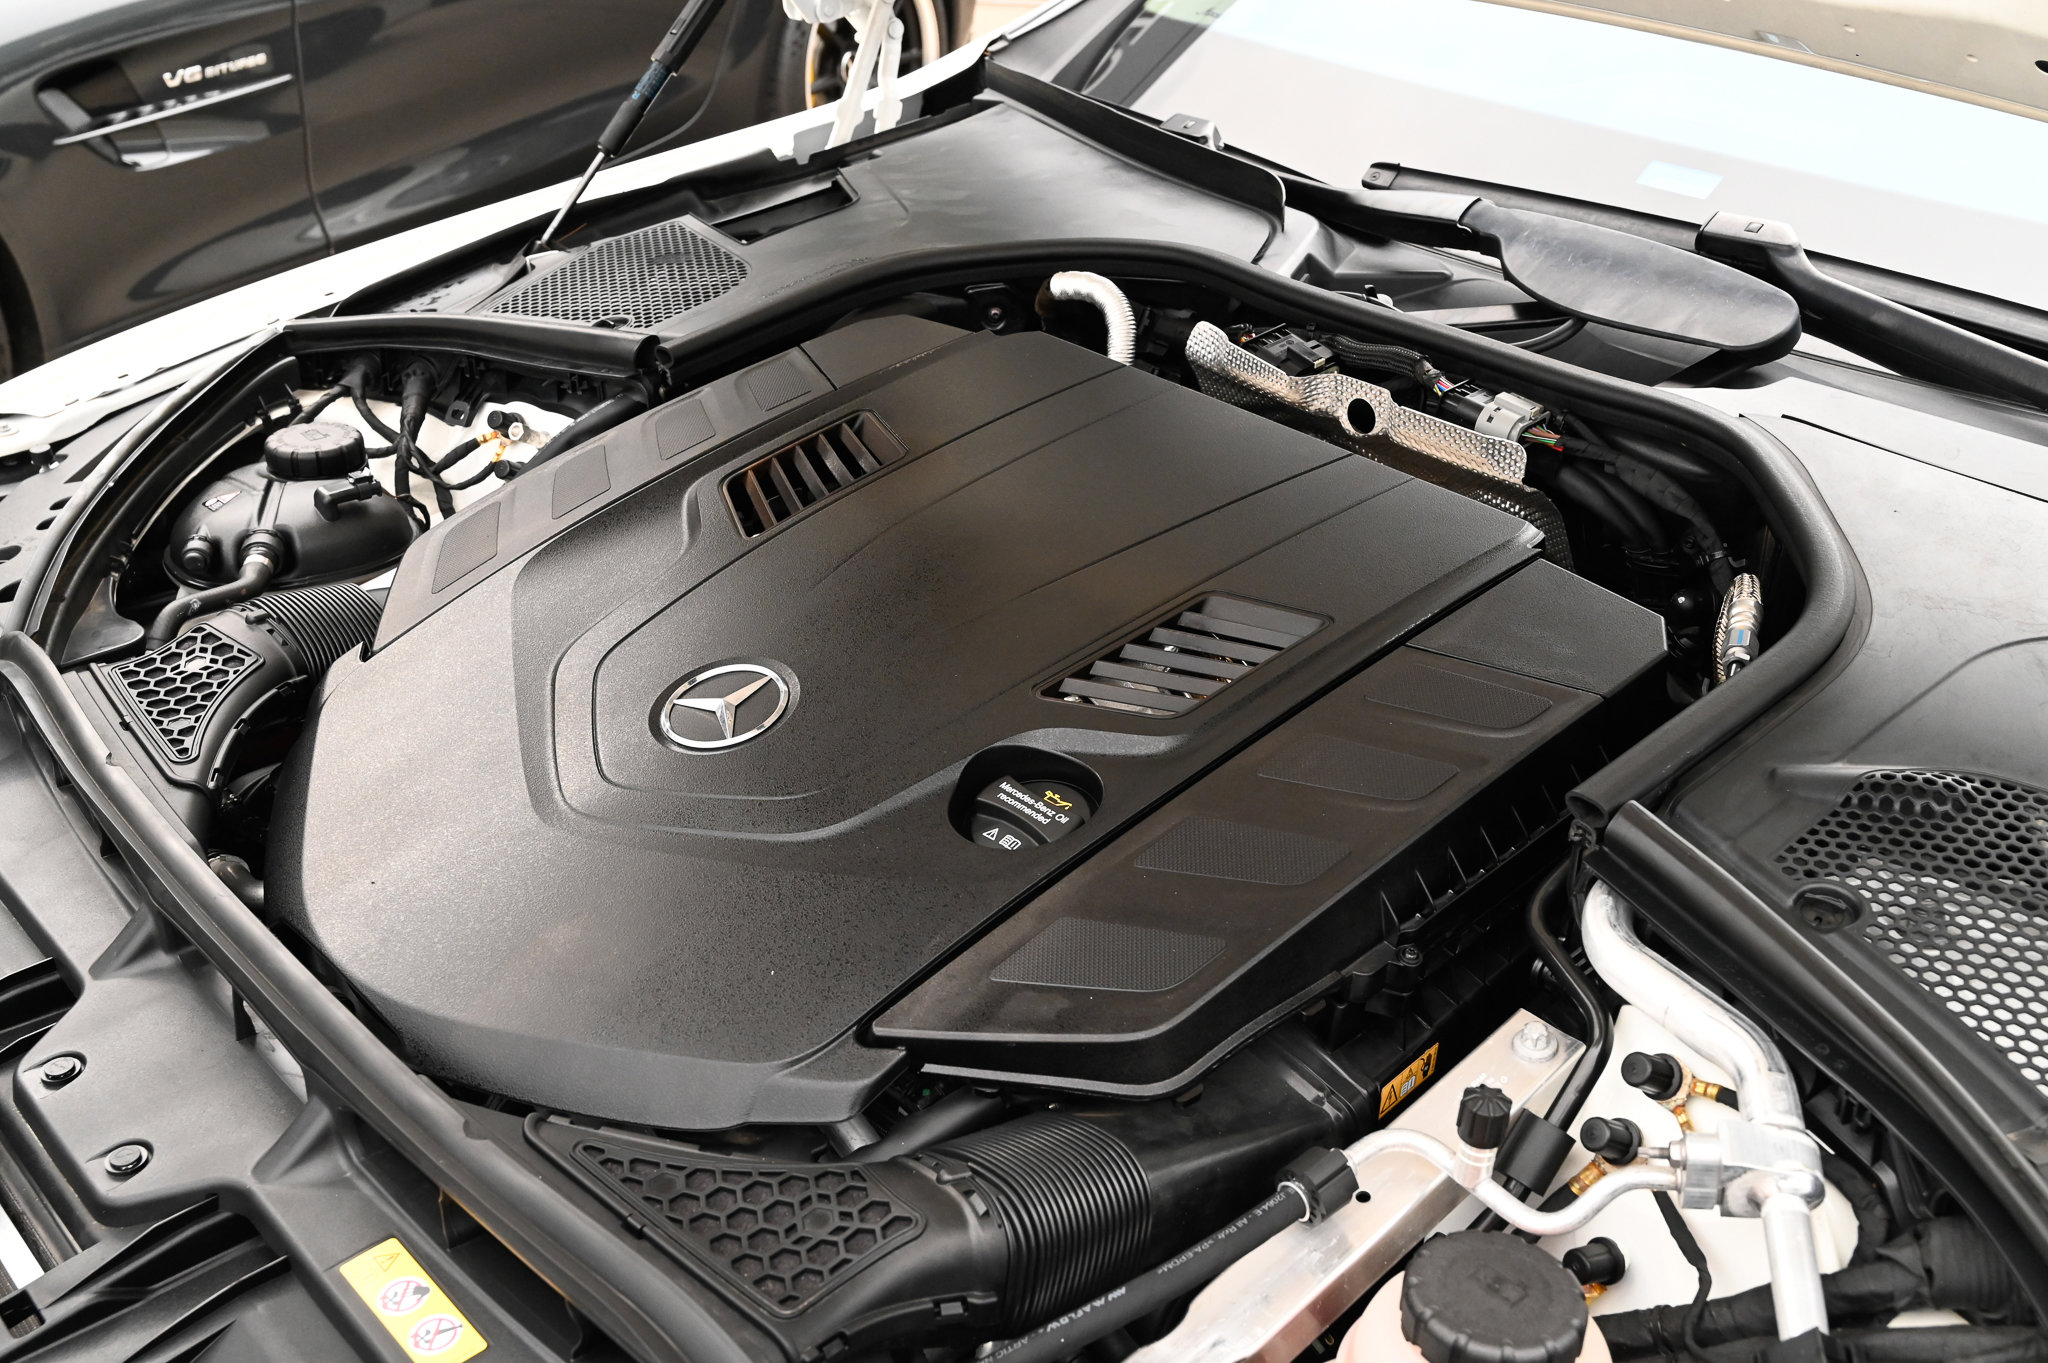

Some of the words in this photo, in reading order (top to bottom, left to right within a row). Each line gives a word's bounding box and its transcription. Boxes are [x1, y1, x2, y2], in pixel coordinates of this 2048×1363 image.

[997, 792, 1051, 825] recommended
[999, 782, 1056, 817] Mercedes-Benz
[1055, 813, 1070, 824] Oil
